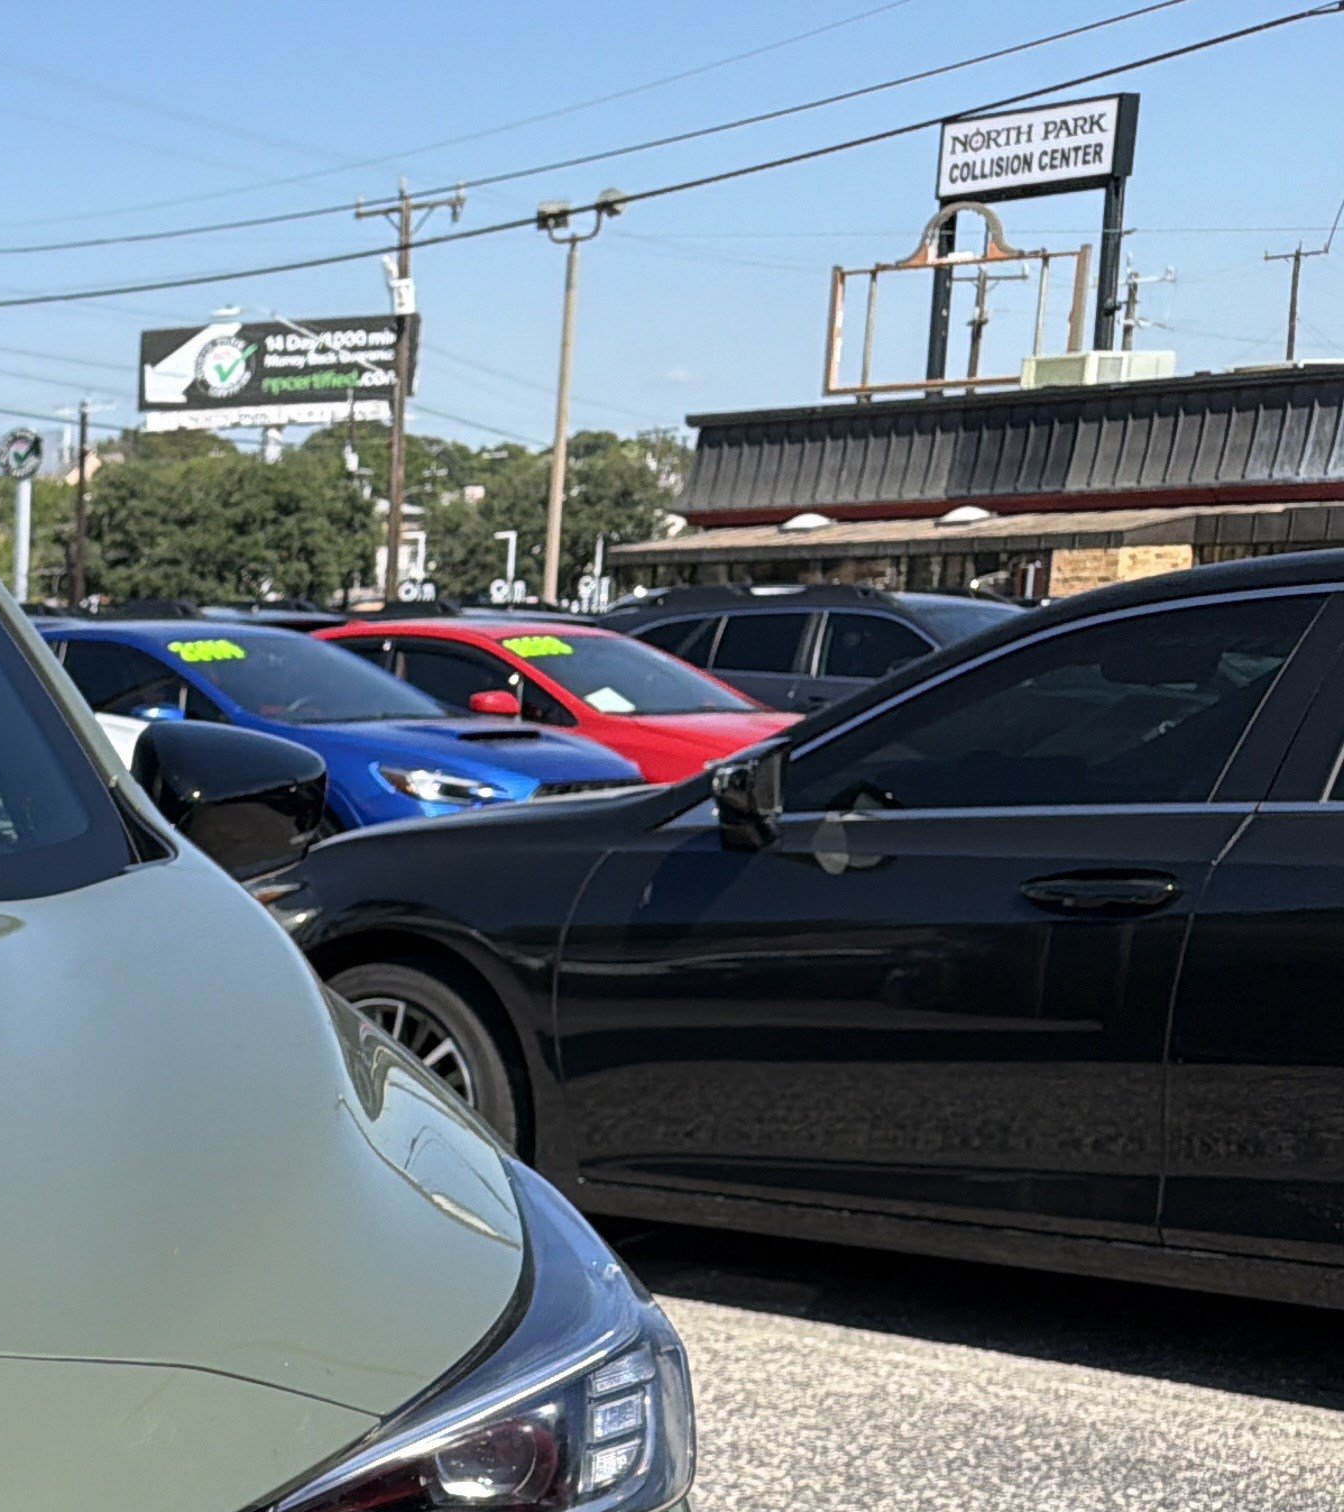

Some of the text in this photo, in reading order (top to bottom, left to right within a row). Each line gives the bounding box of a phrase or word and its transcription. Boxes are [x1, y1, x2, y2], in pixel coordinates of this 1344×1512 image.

[950, 113, 1107, 155] NORTH PARK
[949, 143, 1104, 184] COLLISION CENTER
